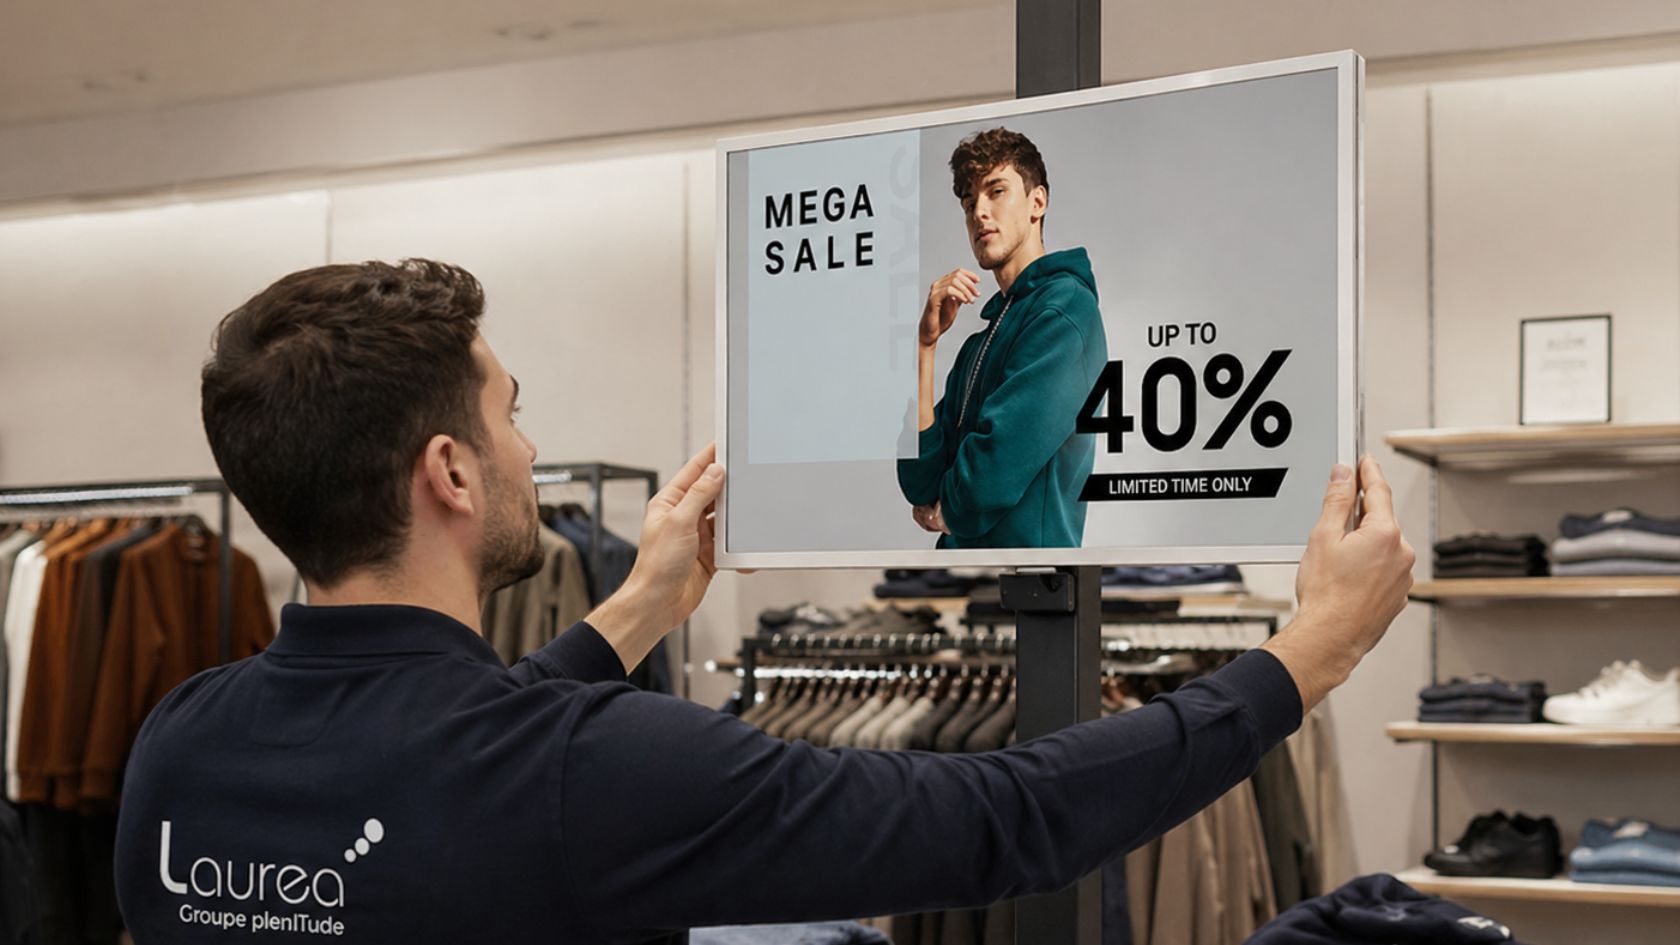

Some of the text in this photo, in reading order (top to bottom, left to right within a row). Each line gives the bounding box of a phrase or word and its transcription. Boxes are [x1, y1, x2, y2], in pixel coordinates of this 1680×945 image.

[765, 183, 874, 229] MEGA
[765, 231, 874, 276] SALE
[1148, 322, 1217, 347] UP TO
[1075, 349, 1293, 454] 40%
[1108, 476, 1253, 495] LIMITED TIME ONLY
[159, 820, 344, 907] Laurea
[179, 903, 345, 936] Groupe plenITude
